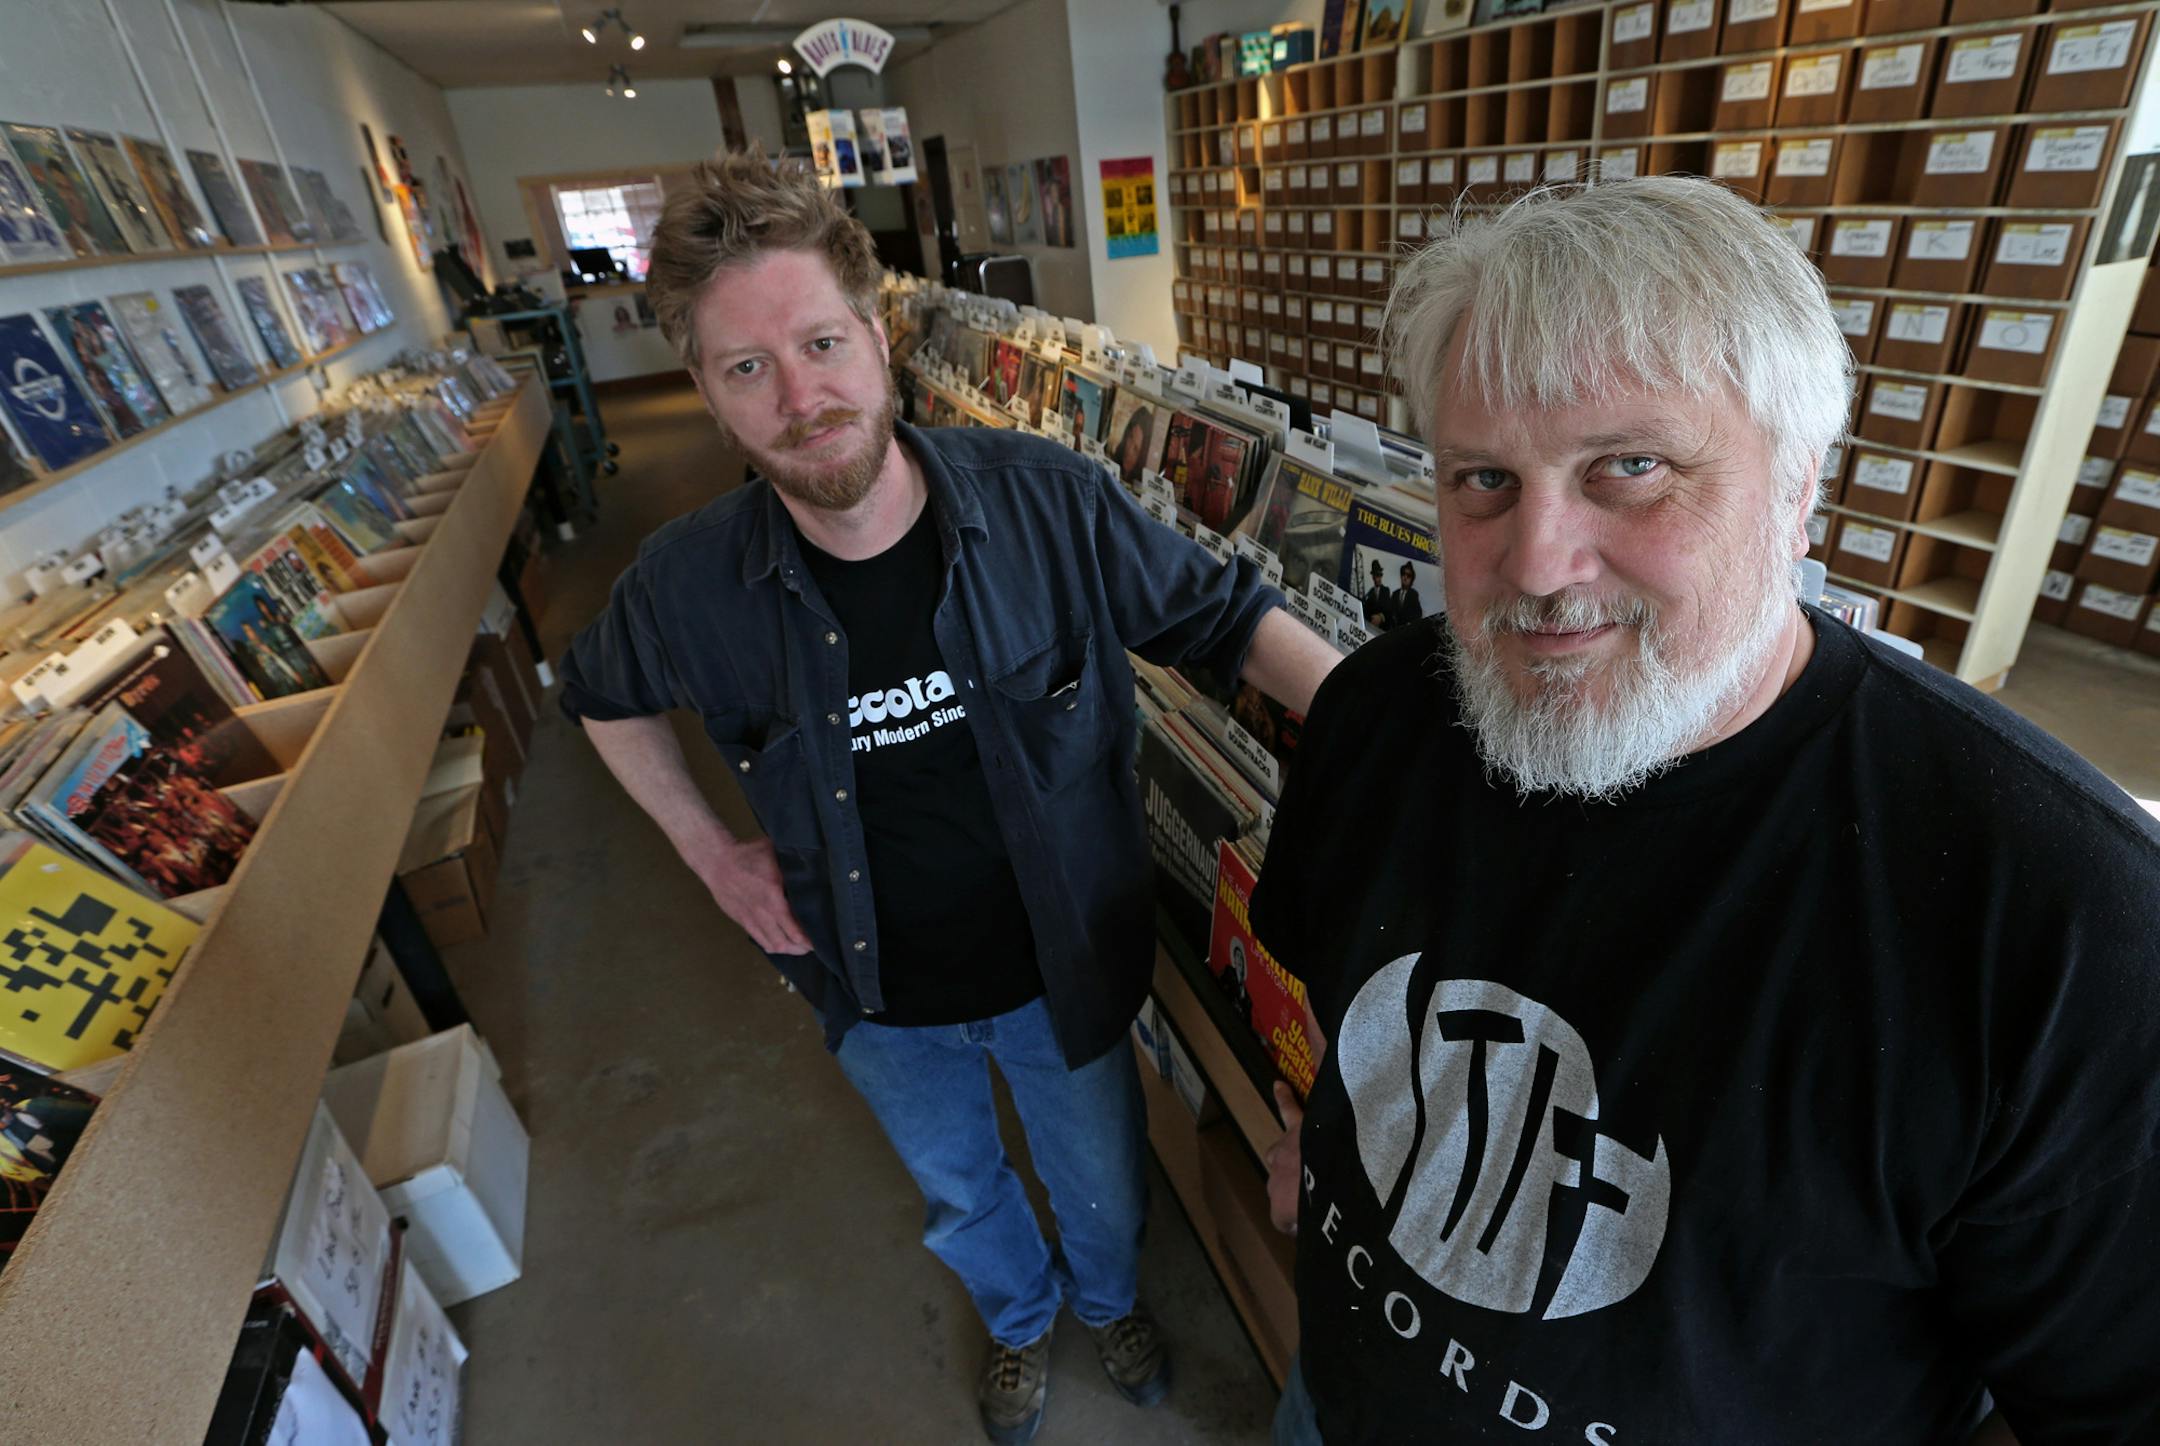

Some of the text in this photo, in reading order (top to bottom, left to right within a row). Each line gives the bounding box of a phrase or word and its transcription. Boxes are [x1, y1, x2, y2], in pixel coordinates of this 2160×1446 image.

[1357, 508, 1378, 529] THE
[1378, 516, 1412, 544] BLUES
[1318, 577, 1334, 595] USED
[1293, 594, 1309, 611] USED
[1312, 587, 1359, 623] SOUNDTRACKS
[1349, 623, 1368, 642] USED
[873, 720, 931, 748] Modern
[1145, 777, 1218, 886] JUGGERNAUT
